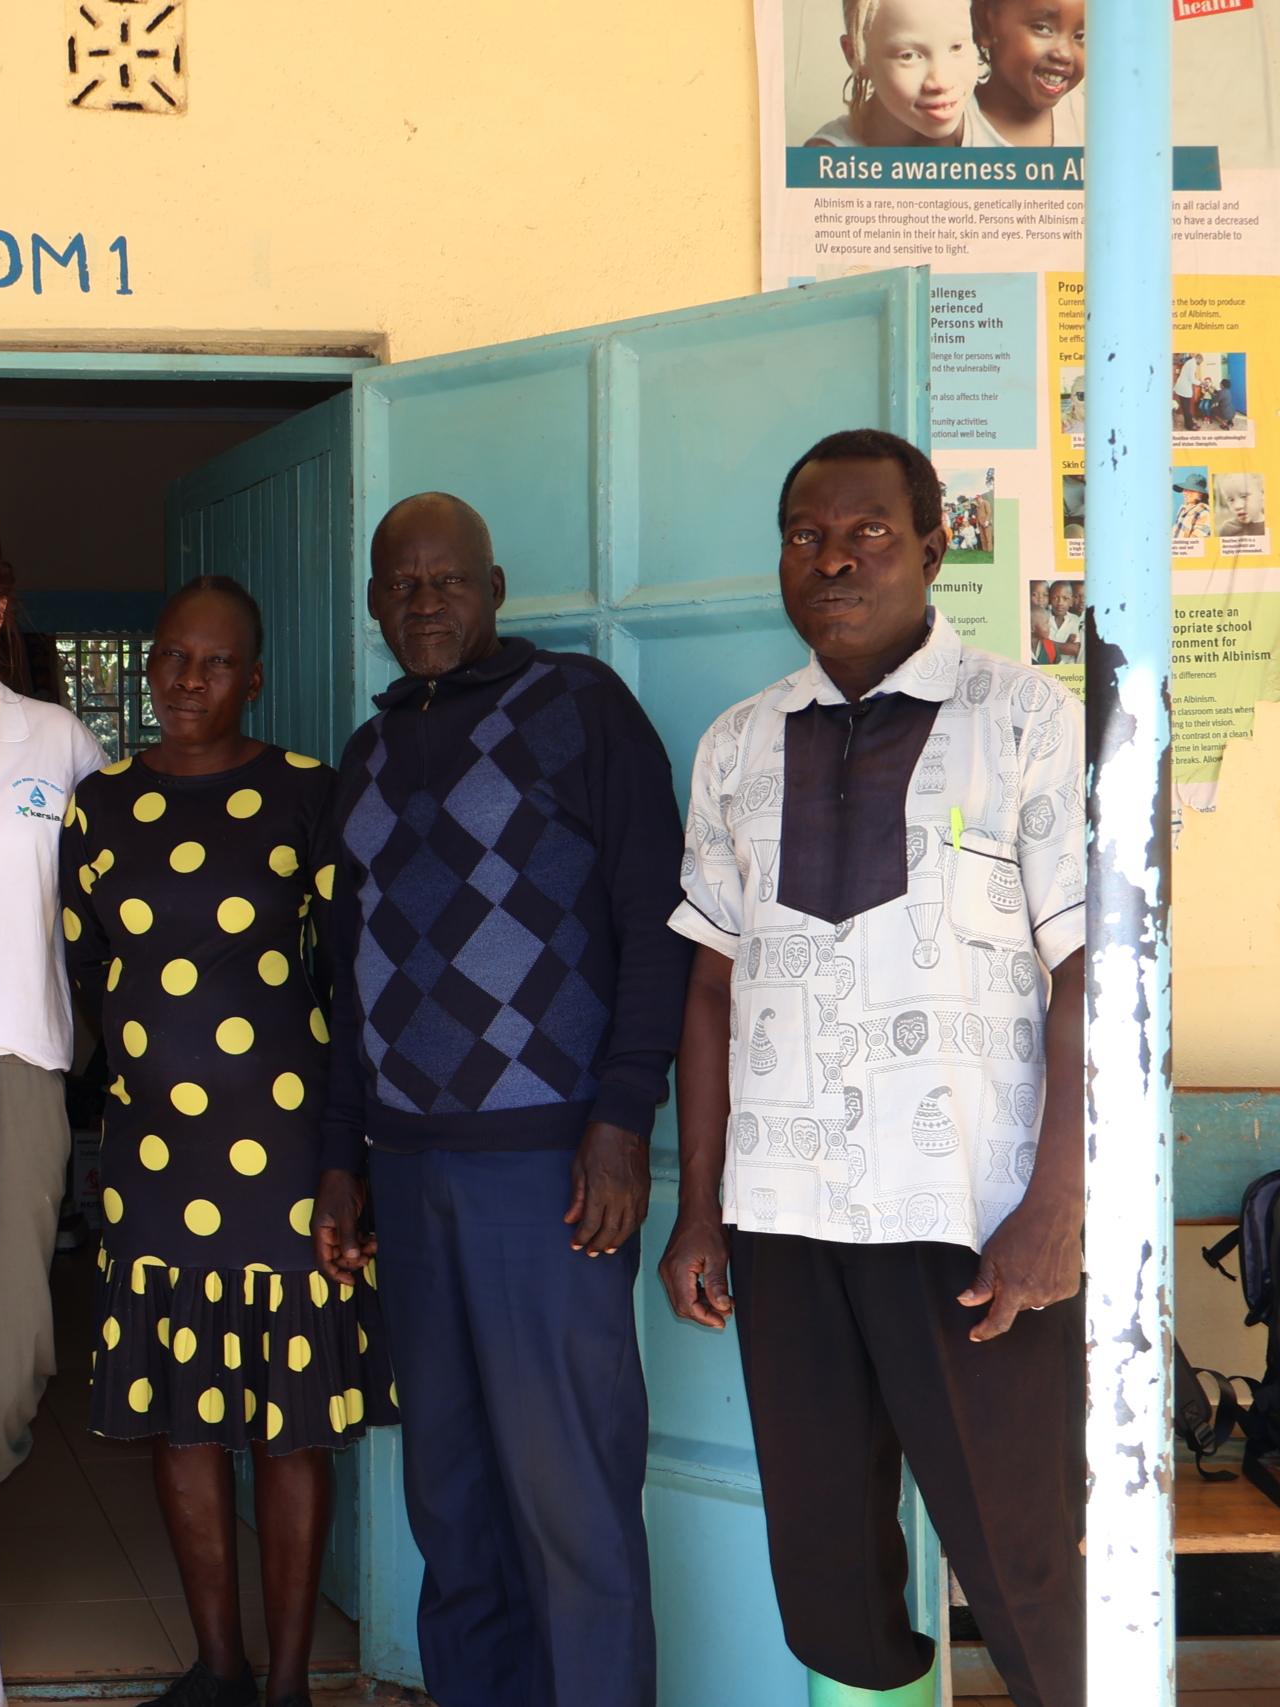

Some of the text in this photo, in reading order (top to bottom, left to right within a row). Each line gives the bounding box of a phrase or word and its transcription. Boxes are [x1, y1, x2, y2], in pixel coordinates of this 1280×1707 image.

[819, 155, 883, 180] Raise
[891, 161, 1017, 181] awareness
[1025, 162, 1055, 181] on
[814, 198, 855, 209] Albinism
[856, 198, 864, 209] is
[866, 200, 872, 209] a
[874, 200, 894, 211] rare,
[896, 199, 972, 211] non-contagious,
[973, 199, 1022, 212] genetically
[1023, 199, 1064, 210] inherited
[1183, 200, 1194, 210] all
[1196, 200, 1220, 210] racial
[1222, 200, 1240, 210] and
[814, 213, 843, 224] ethnic
[845, 215, 876, 226] groups
[878, 213, 929, 226] throughout
[931, 213, 946, 224] the
[948, 213, 977, 224] world.
[978, 214, 1014, 225] Persons
[1016, 213, 1036, 225] with
[1038, 214, 1079, 225] Albinism
[1184, 215, 1205, 225] have
[1206, 217, 1213, 225] a
[1214, 215, 1259, 226] decreased
[814, 228, 1082, 241] amount of melanin in their hair, skin and eyes. Persons with
[1184, 229, 1242, 240] vulnerable to
[815, 243, 970, 256] UV exposure and sensitive to light.
[930, 287, 977, 300] allenges
[1176, 297, 1246, 308] the body to produce
[930, 303, 983, 316] erienced
[1179, 309, 1222, 318] of Albinism.
[931, 317, 1004, 329] Persons with
[1193, 321, 1239, 331] Albinism can
[931, 333, 966, 344] inism
[1059, 334, 1068, 343] be
[931, 352, 1011, 362] llenge for persons with
[1059, 352, 1072, 361] Eye
[943, 364, 1001, 374] the vulnerability
[939, 393, 955, 402] also
[956, 393, 980, 402] affects
[981, 393, 999, 402] their
[956, 417, 989, 427] activities
[960, 430, 997, 440] well being
[1062, 460, 1079, 469] Skin
[932, 581, 983, 594] mmunity
[1174, 608, 1239, 619] to create an
[957, 615, 988, 625] support.
[961, 628, 976, 636] and
[1171, 620, 1252, 636] opriate school
[1171, 636, 1237, 649] ronment for
[1194, 651, 1220, 663] with
[1222, 650, 1271, 662] Albinism
[1178, 671, 1217, 680] differences
[1172, 695, 1218, 704] on Albinism.
[1177, 707, 1214, 716] classroom
[1214, 706, 1234, 715] seats
[1185, 720, 1193, 728] to
[1193, 719, 1210, 728] their
[1211, 718, 1236, 727] vision.
[1181, 731, 1211, 741] contrast
[1211, 731, 1222, 739] on
[1229, 730, 1248, 738] clean
[1175, 743, 1227, 752] time in learnin
[1175, 756, 1202, 765] breaks.
